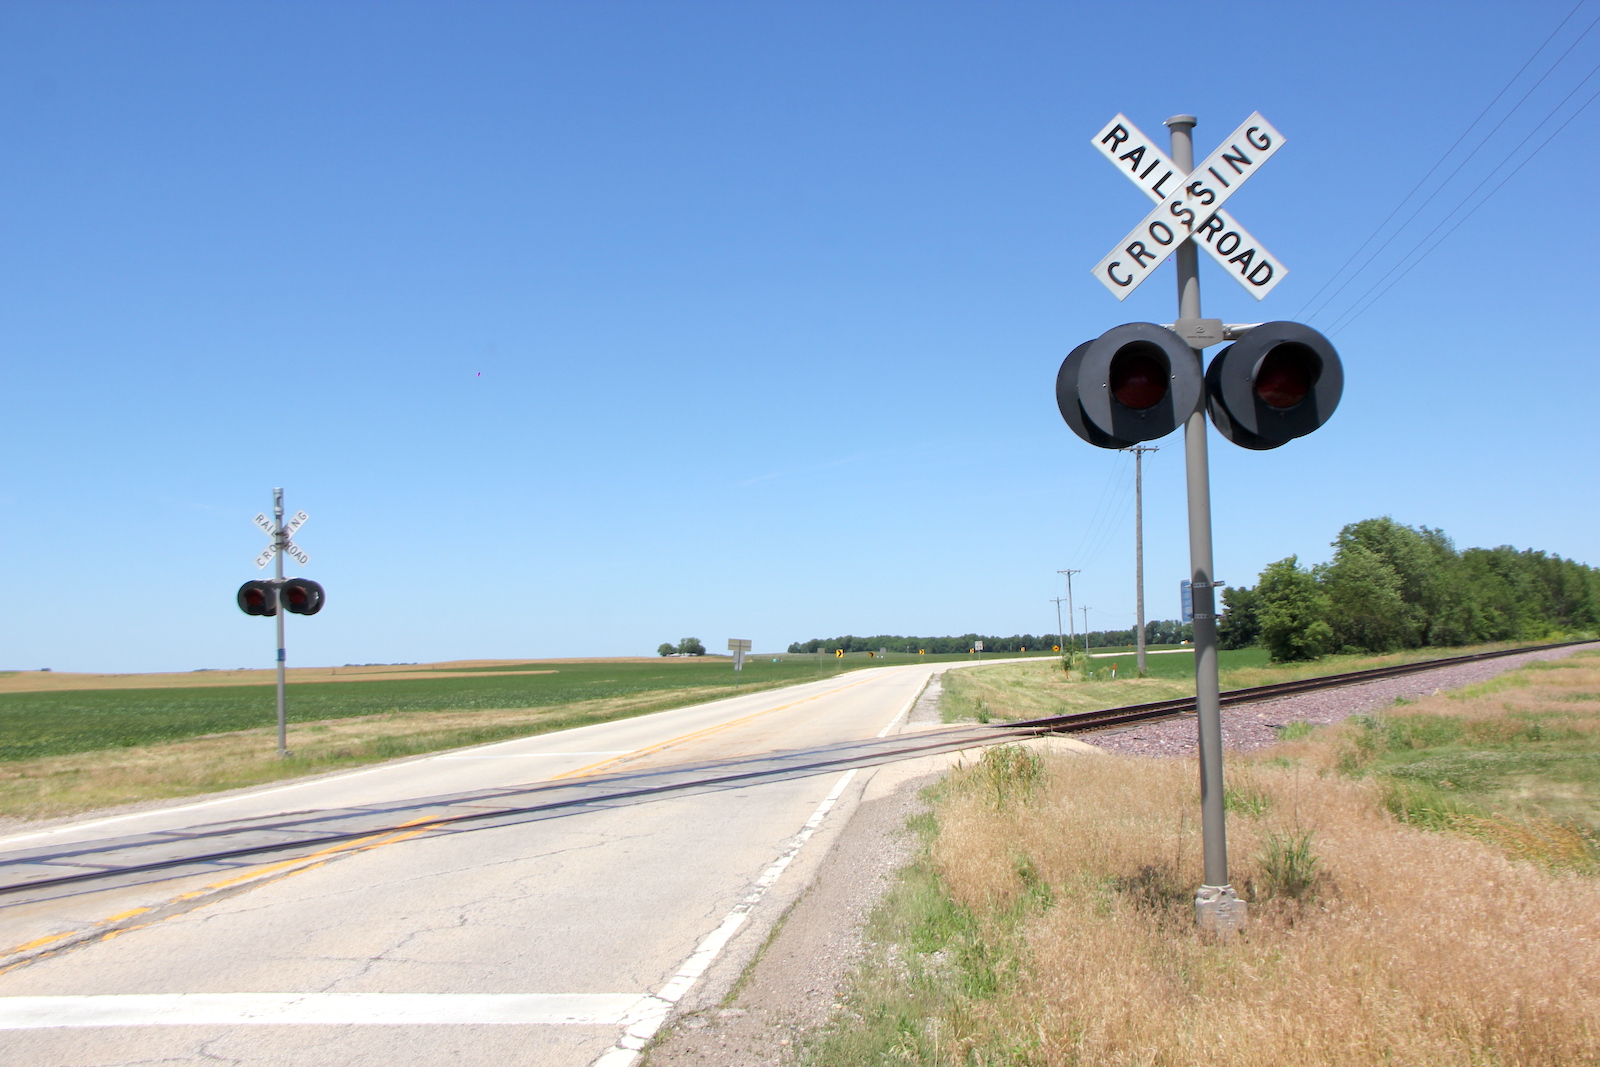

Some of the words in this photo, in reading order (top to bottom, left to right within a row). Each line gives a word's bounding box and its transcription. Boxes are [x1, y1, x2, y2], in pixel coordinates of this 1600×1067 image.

[1101, 123, 1173, 200] RAIL
[1197, 213, 1274, 287] ROAD
[1107, 126, 1272, 287] CROSSING
